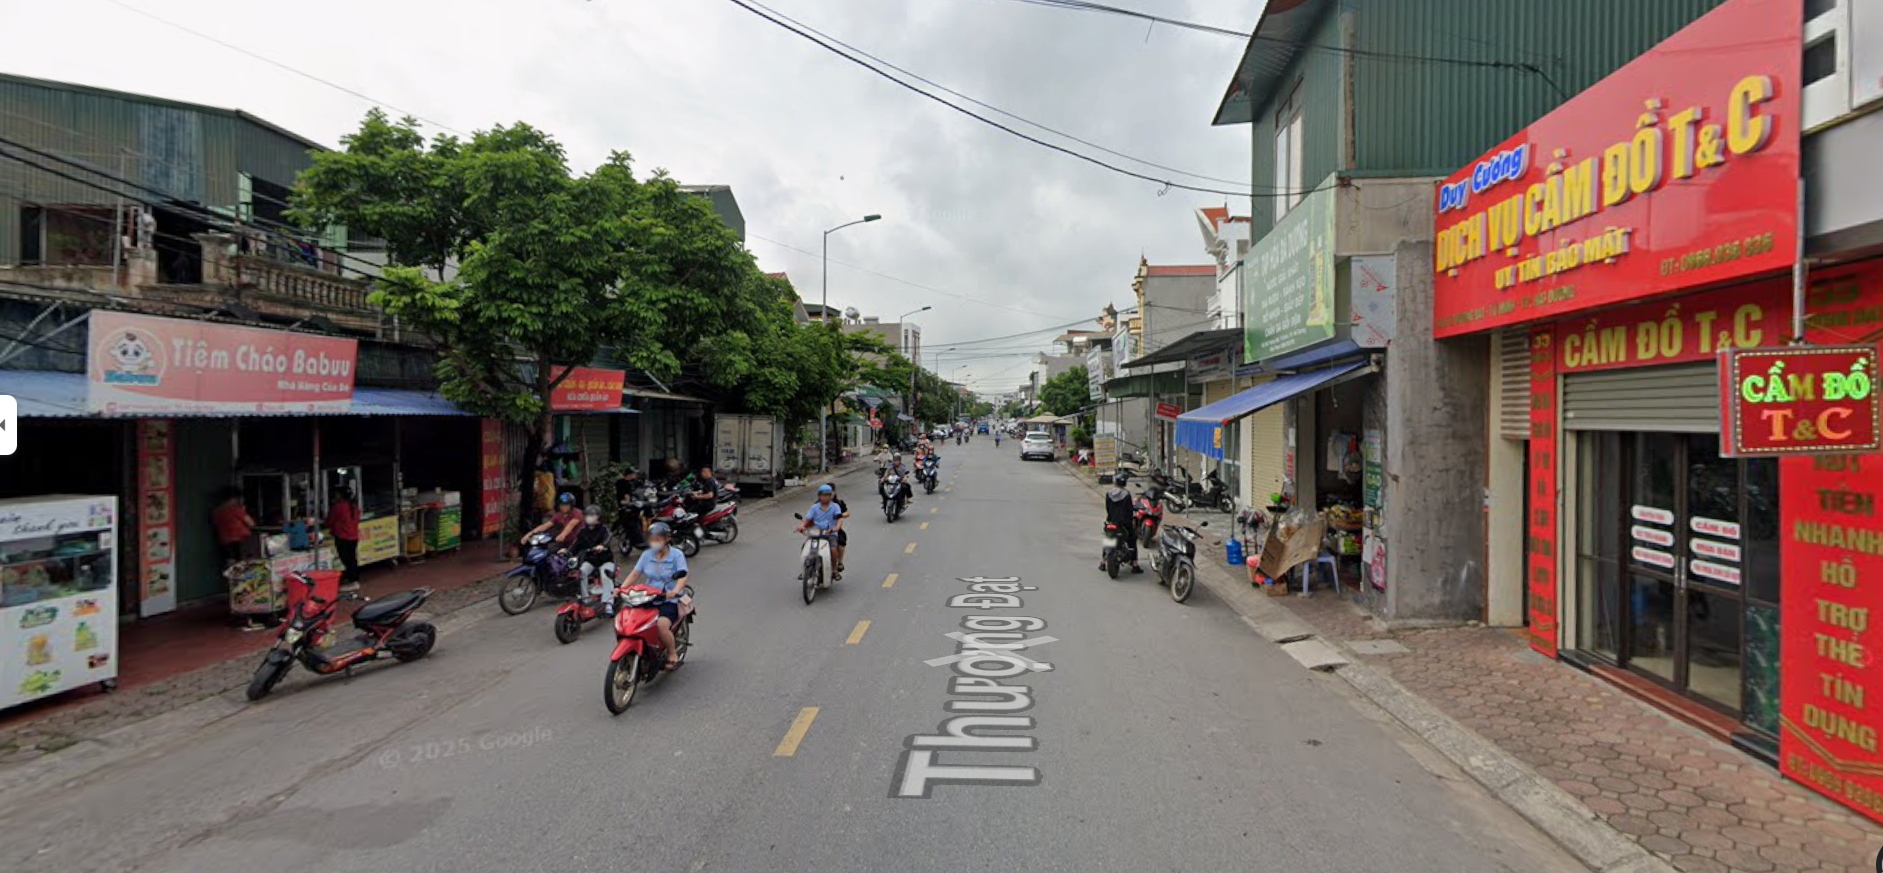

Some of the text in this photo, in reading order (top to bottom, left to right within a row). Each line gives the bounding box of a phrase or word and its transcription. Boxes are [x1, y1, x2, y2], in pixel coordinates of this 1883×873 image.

[1436, 75, 1773, 277] DỊCH VỤ CẦM ĐỒ T&C
[1439, 145, 1527, 213] Duy Cương
[1495, 226, 1631, 289] UY TÍN BẢO MẬT
[1564, 318, 1627, 368] CẦM
[1636, 302, 1683, 360] ĐỒ
[1695, 304, 1763, 354] T&C
[172, 338, 350, 377] Tiệm Cháo Babuu
[1742, 356, 1871, 403] CẦM ĐỒ
[1761, 407, 1853, 441] T&C
[1818, 482, 1874, 517] TIỀN
[1795, 519, 1883, 556] NHANH
[1820, 556, 1857, 588] HỖ
[1817, 599, 1869, 636] TRỢ
[1815, 633, 1866, 669] THẺ
[1820, 672, 1864, 709] TÍN
[1803, 703, 1878, 752] DỤNG
